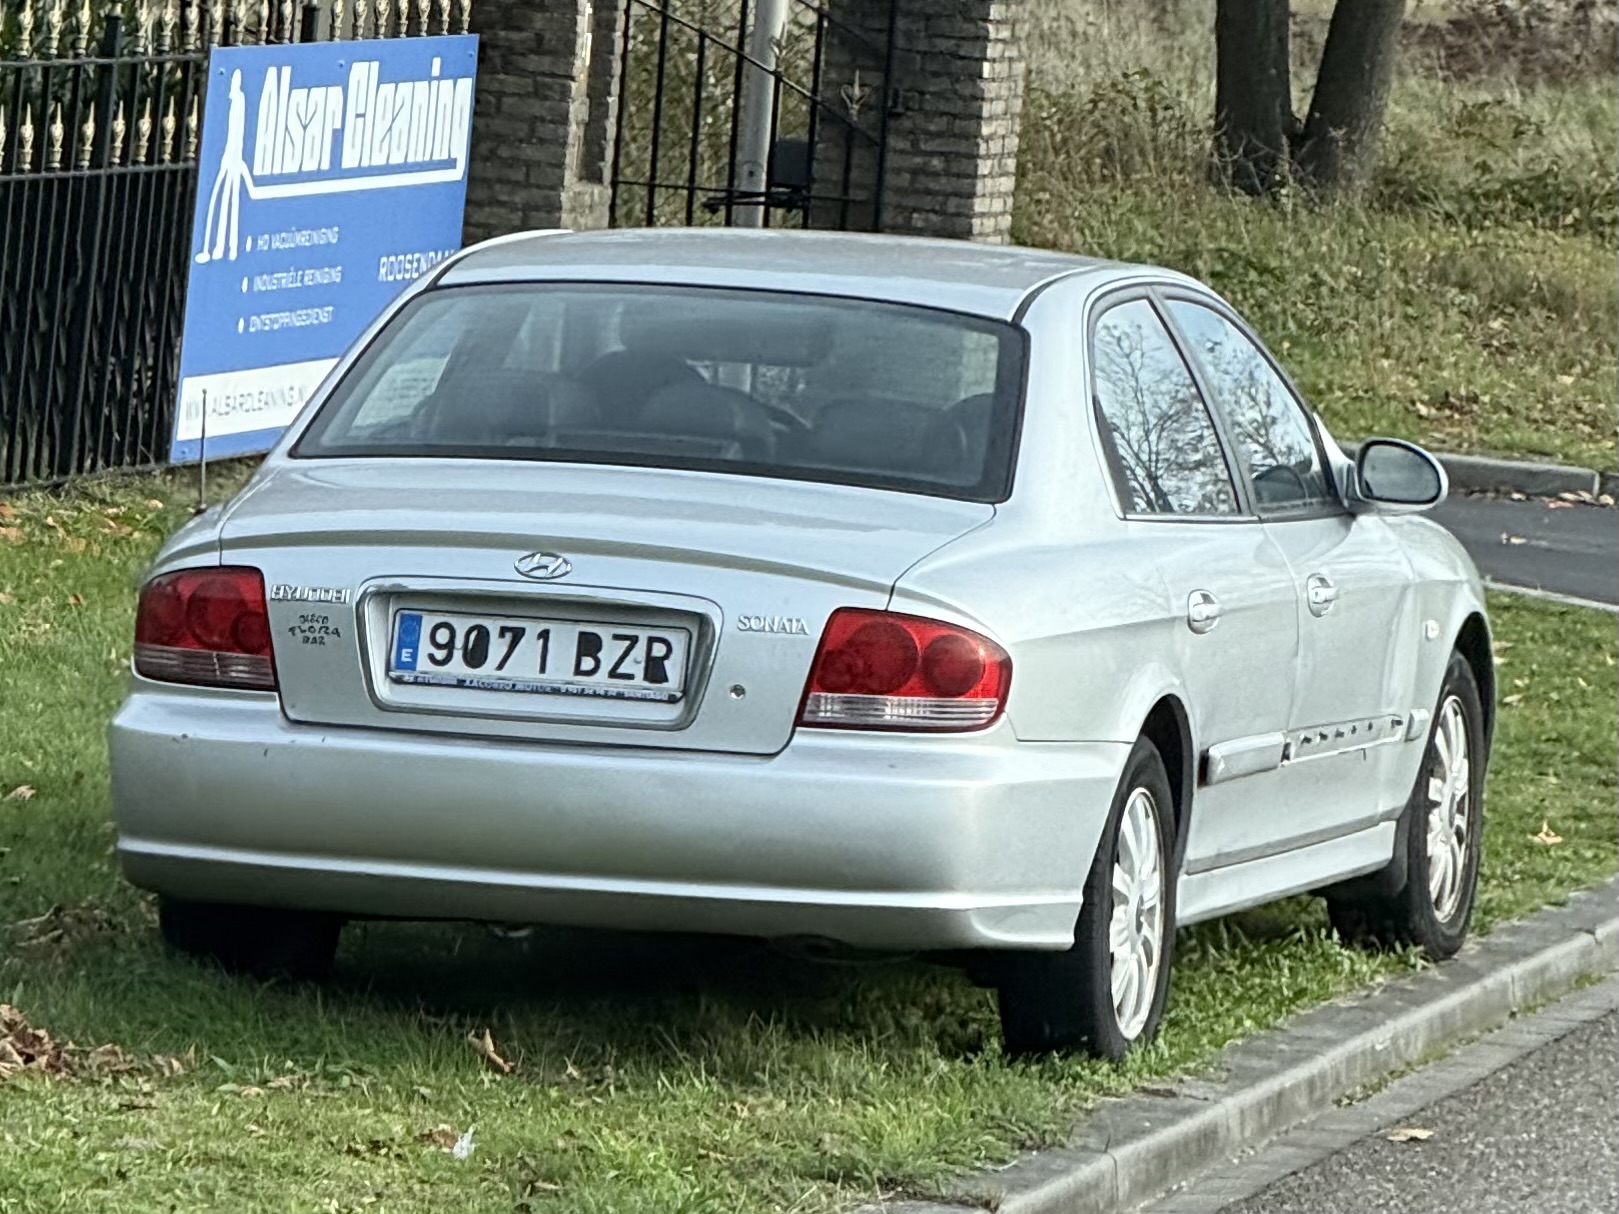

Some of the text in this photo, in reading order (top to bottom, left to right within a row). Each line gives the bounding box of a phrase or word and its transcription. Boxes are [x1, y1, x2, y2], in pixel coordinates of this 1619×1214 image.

[253, 57, 473, 176] Alsar Cleaning
[378, 249, 456, 282] ROOSEND
[271, 584, 351, 604] HYUNDAI
[737, 615, 810, 635] SONATA
[401, 648, 413, 662] E
[427, 621, 673, 684] 9071 BZR
